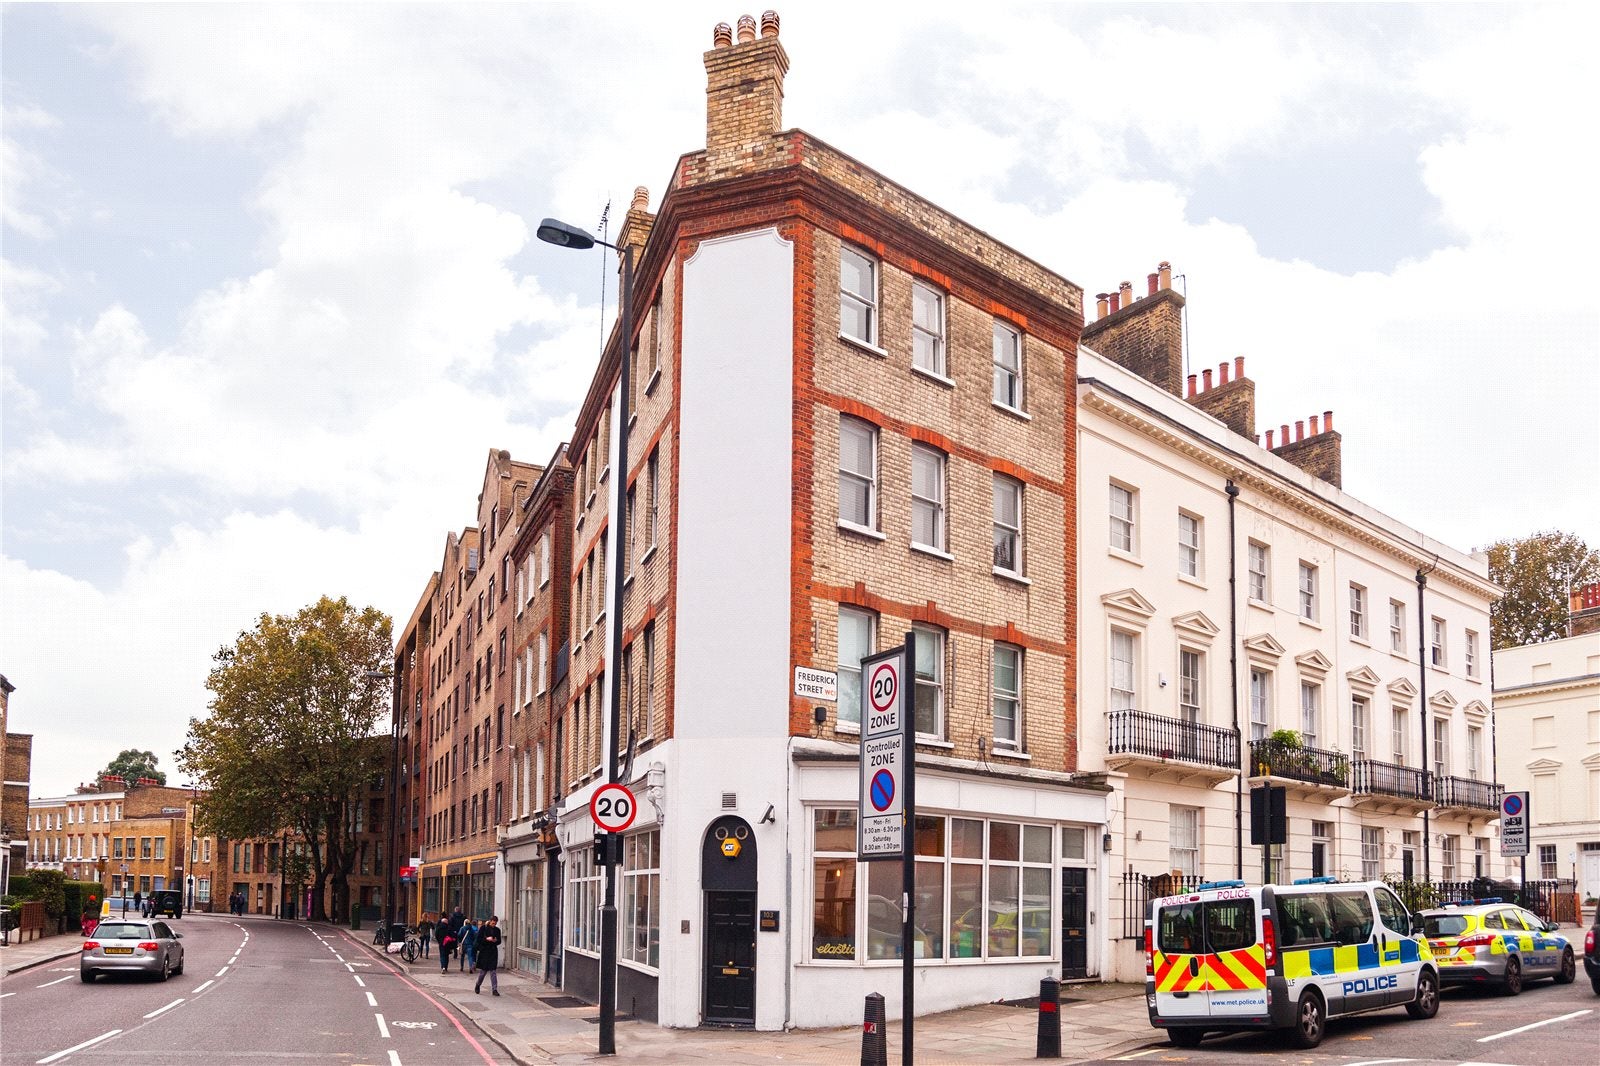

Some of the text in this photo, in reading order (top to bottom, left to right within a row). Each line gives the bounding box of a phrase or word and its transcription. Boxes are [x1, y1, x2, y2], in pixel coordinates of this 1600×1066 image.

[798, 671, 835, 685] FREDERICK
[798, 683, 823, 694] STREET
[874, 676, 893, 699] 20
[870, 713, 896, 729] ZONE
[866, 739, 900, 753] Controlled
[870, 753, 895, 767] ZONE
[598, 797, 630, 818] 20
[1161, 895, 1190, 906] POLICE
[1217, 889, 1250, 900] POLICE
[816, 943, 855, 954] elastic
[1523, 956, 1557, 966] POLICE
[1343, 975, 1398, 996] POLICE
